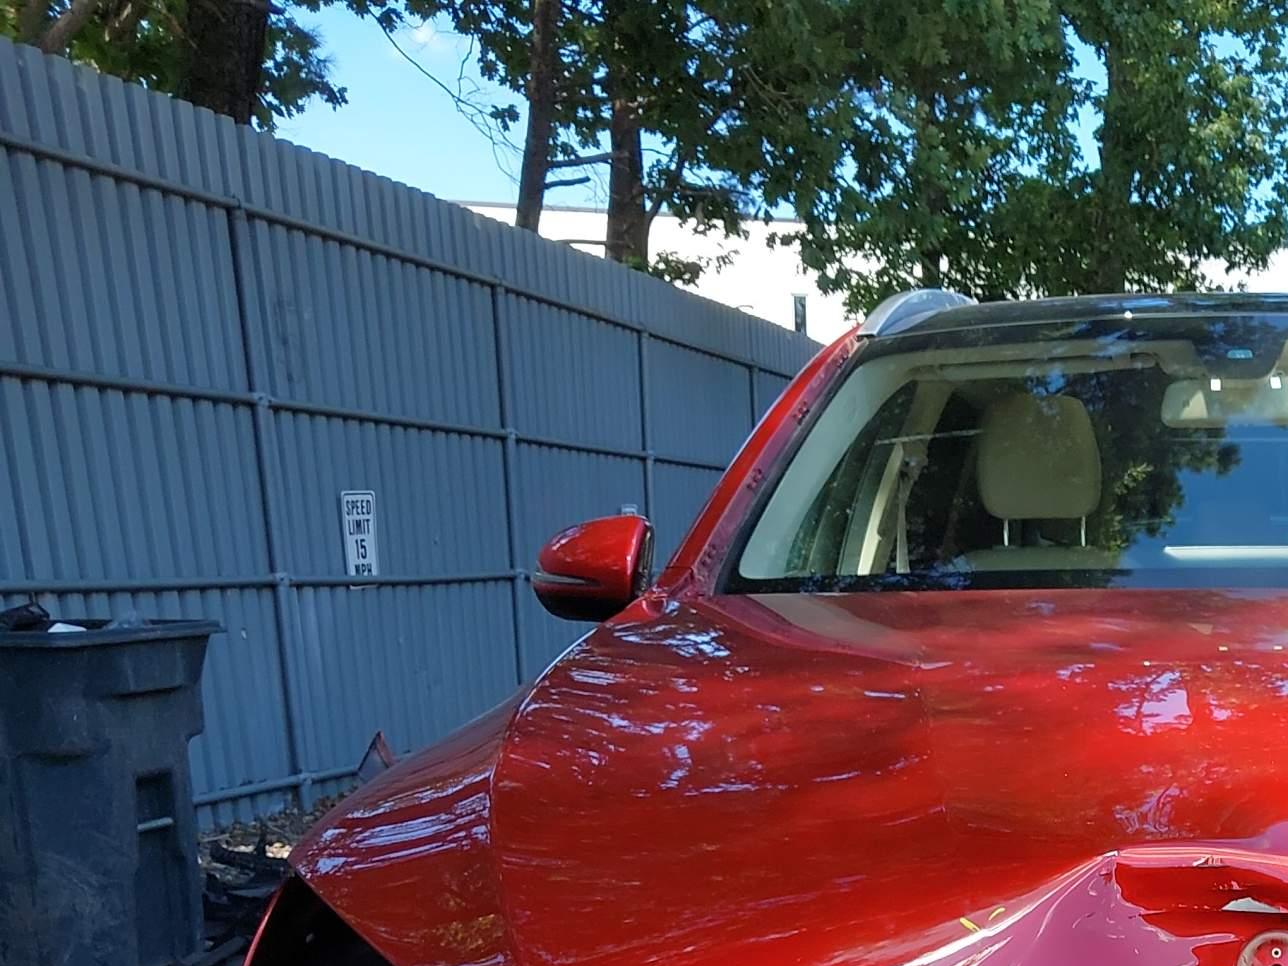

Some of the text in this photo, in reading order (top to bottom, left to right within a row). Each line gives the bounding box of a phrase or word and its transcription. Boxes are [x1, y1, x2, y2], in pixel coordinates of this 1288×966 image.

[345, 500, 371, 516] SPEED
[347, 519, 370, 536] LIMIT
[355, 539, 367, 560] 15
[354, 563, 372, 576] MPH
